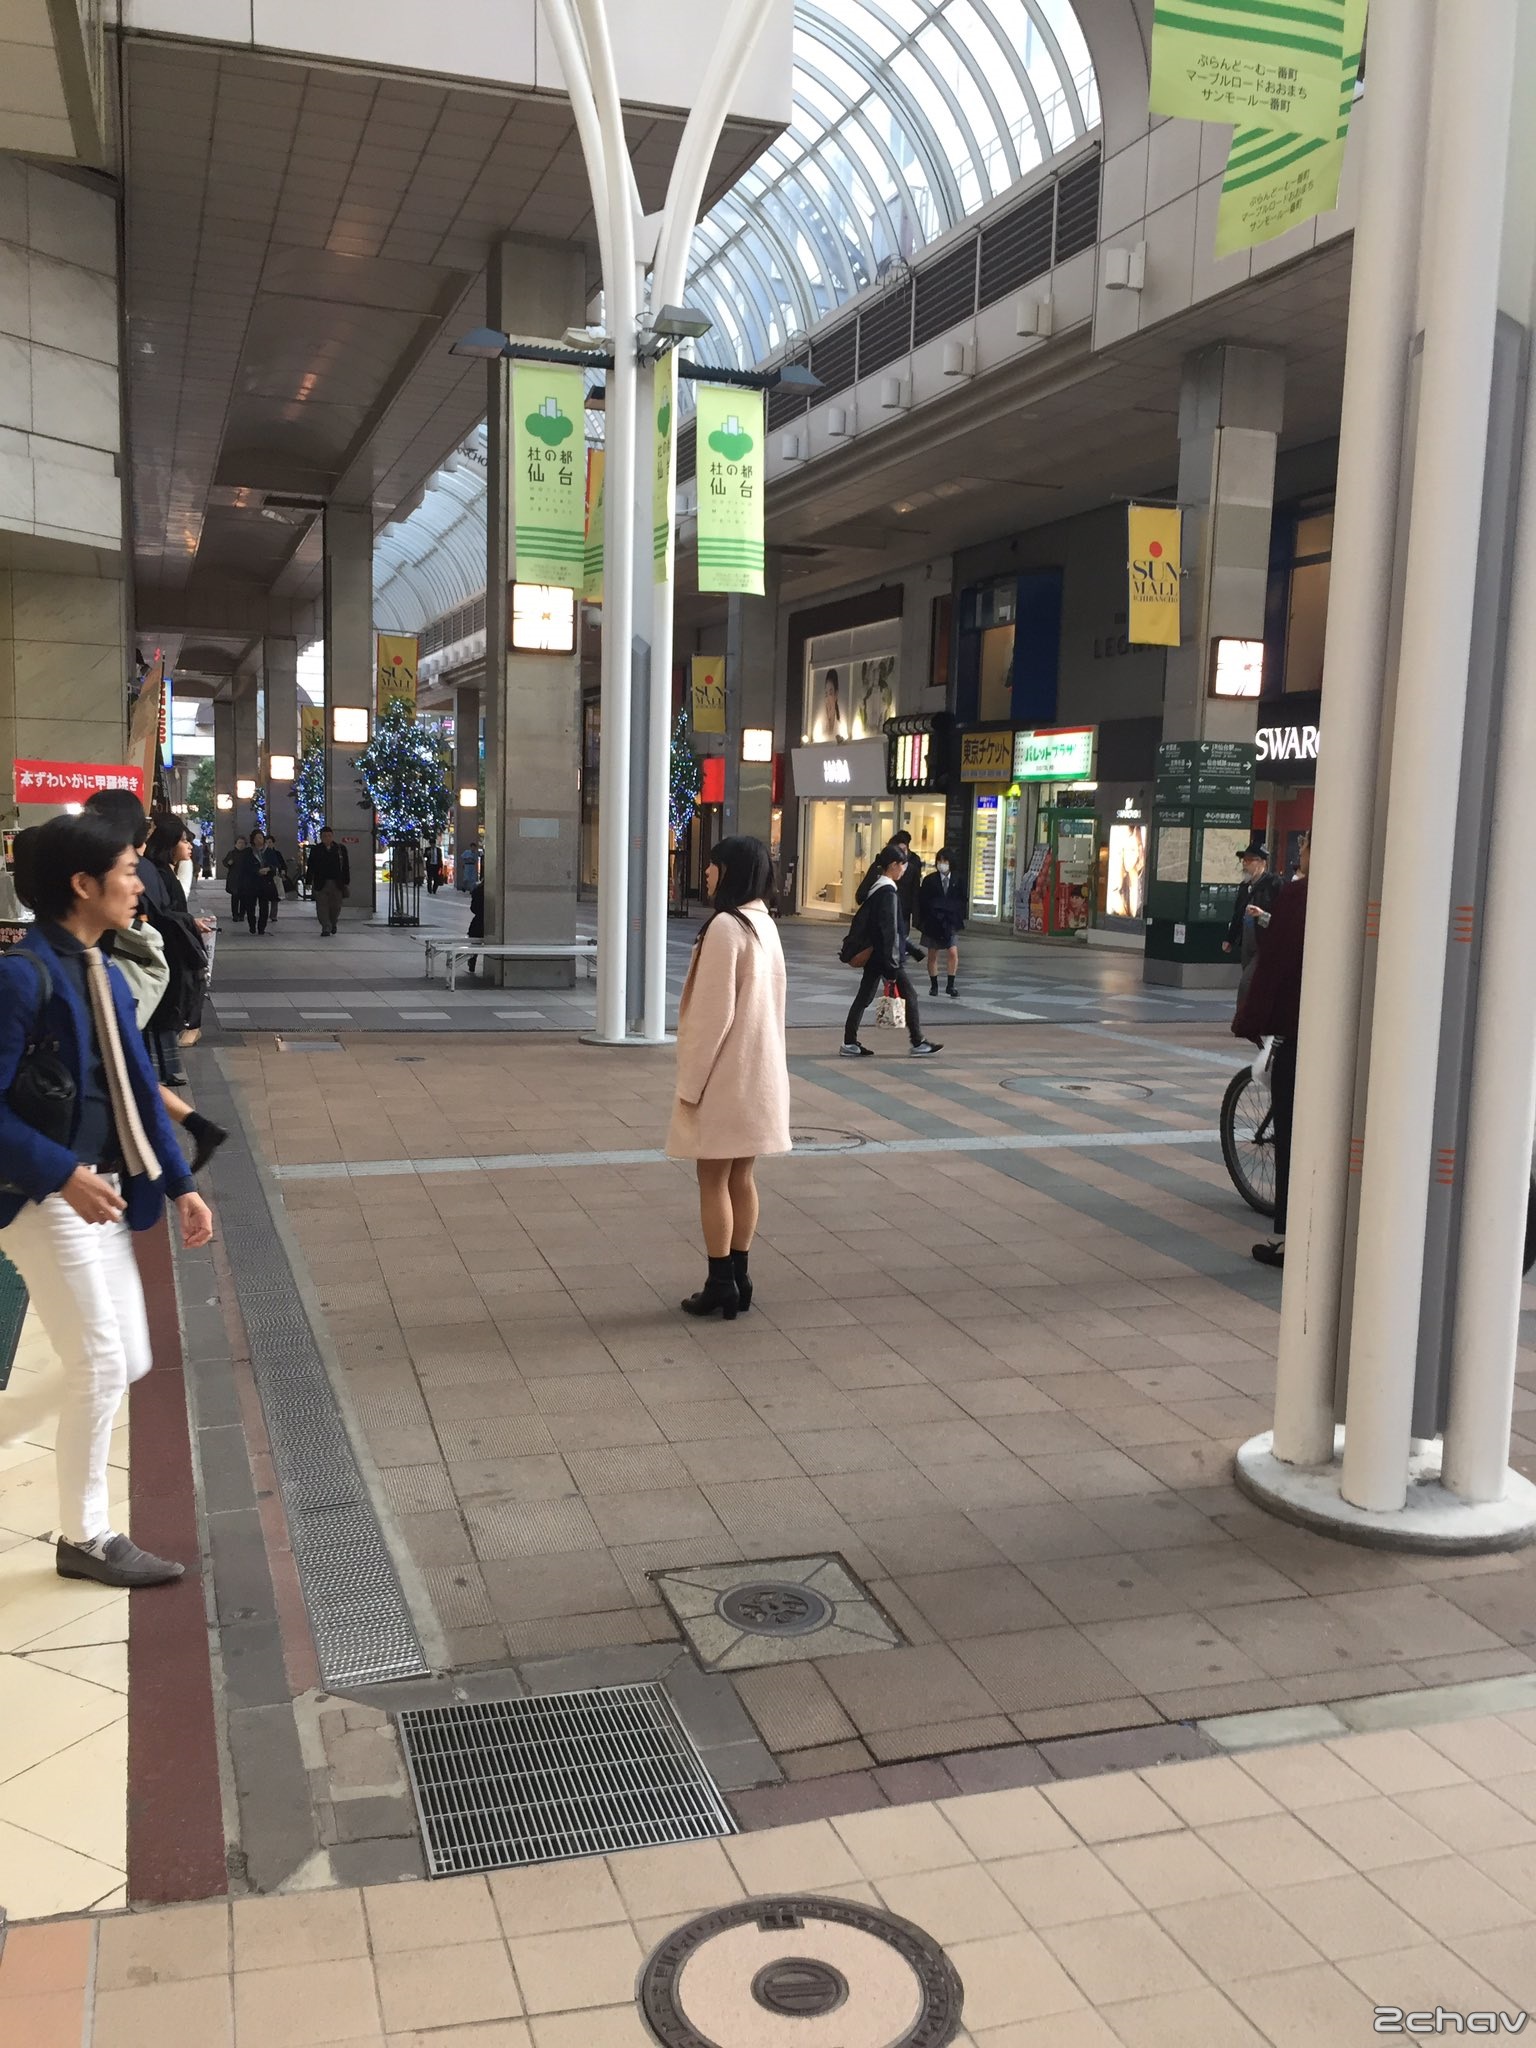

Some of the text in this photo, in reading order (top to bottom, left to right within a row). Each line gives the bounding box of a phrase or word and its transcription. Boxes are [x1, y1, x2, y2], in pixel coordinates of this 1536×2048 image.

[1186, 69, 1308, 100] マーブルロードおおまち
[1201, 88, 1291, 113] サンモール一番町
[527, 446, 573, 465] 杜の都
[527, 463, 573, 486] 仙台
[709, 461, 753, 479] 杜の都
[710, 477, 753, 499] 仙台
[1132, 559, 1179, 582] SUN
[1133, 581, 1178, 596] MALL
[963, 736, 1010, 765] 東京チケット
[1025, 744, 1077, 762] パレットプラザ
[20, 769, 139, 792] 本ずわいがに甲羅焼き
